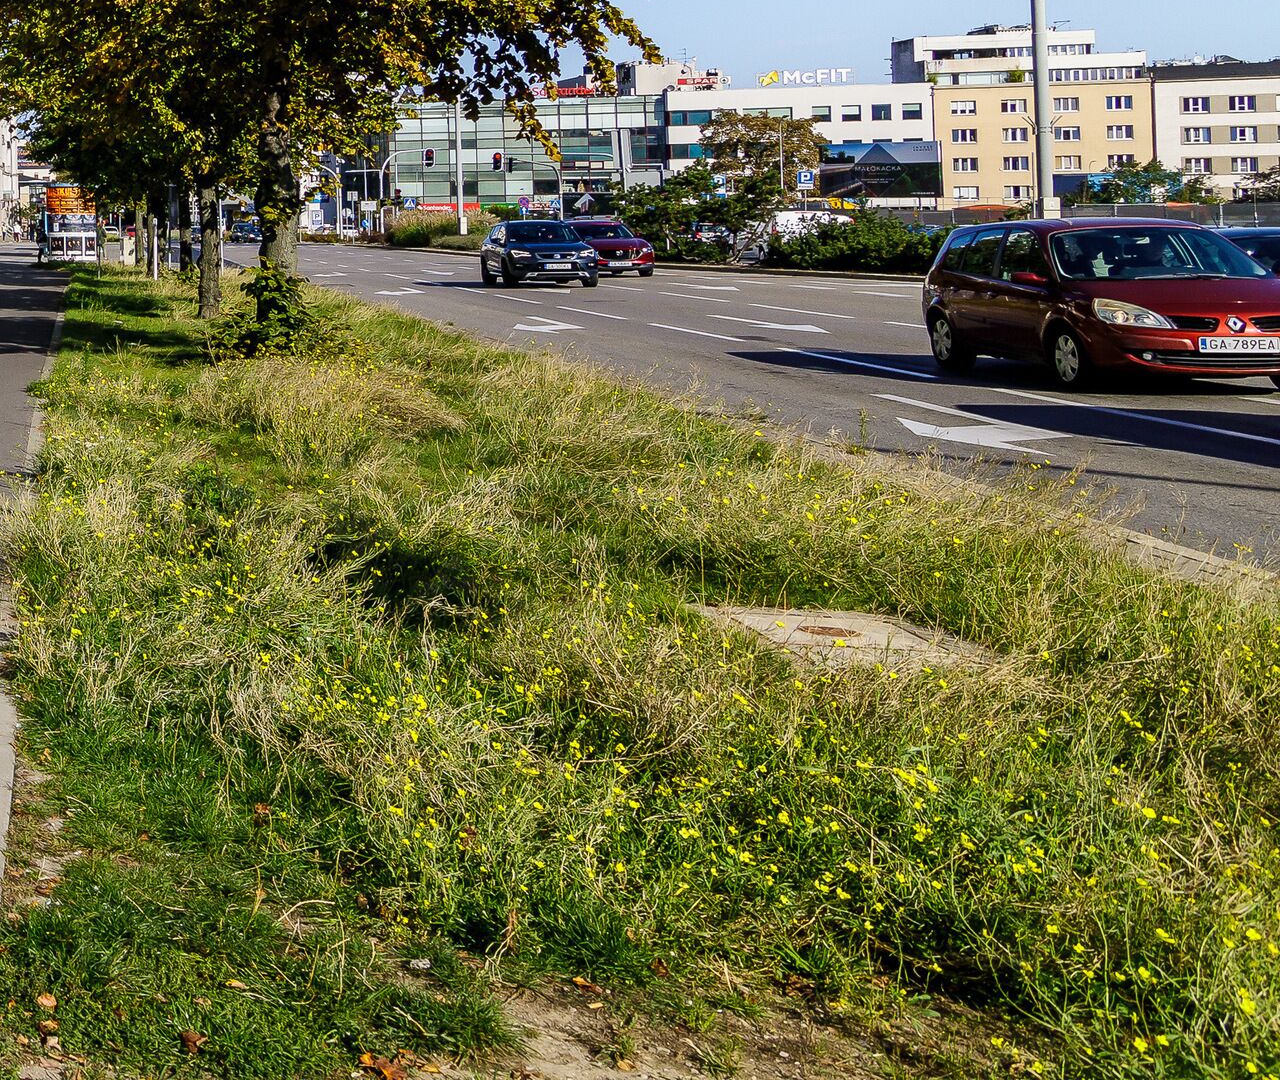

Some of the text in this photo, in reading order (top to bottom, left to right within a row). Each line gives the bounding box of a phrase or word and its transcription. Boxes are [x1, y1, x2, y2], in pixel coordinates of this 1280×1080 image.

[686, 77, 718, 85] SPAR
[783, 68, 852, 84] McFIT
[1209, 339, 1275, 350] GA 789EA
